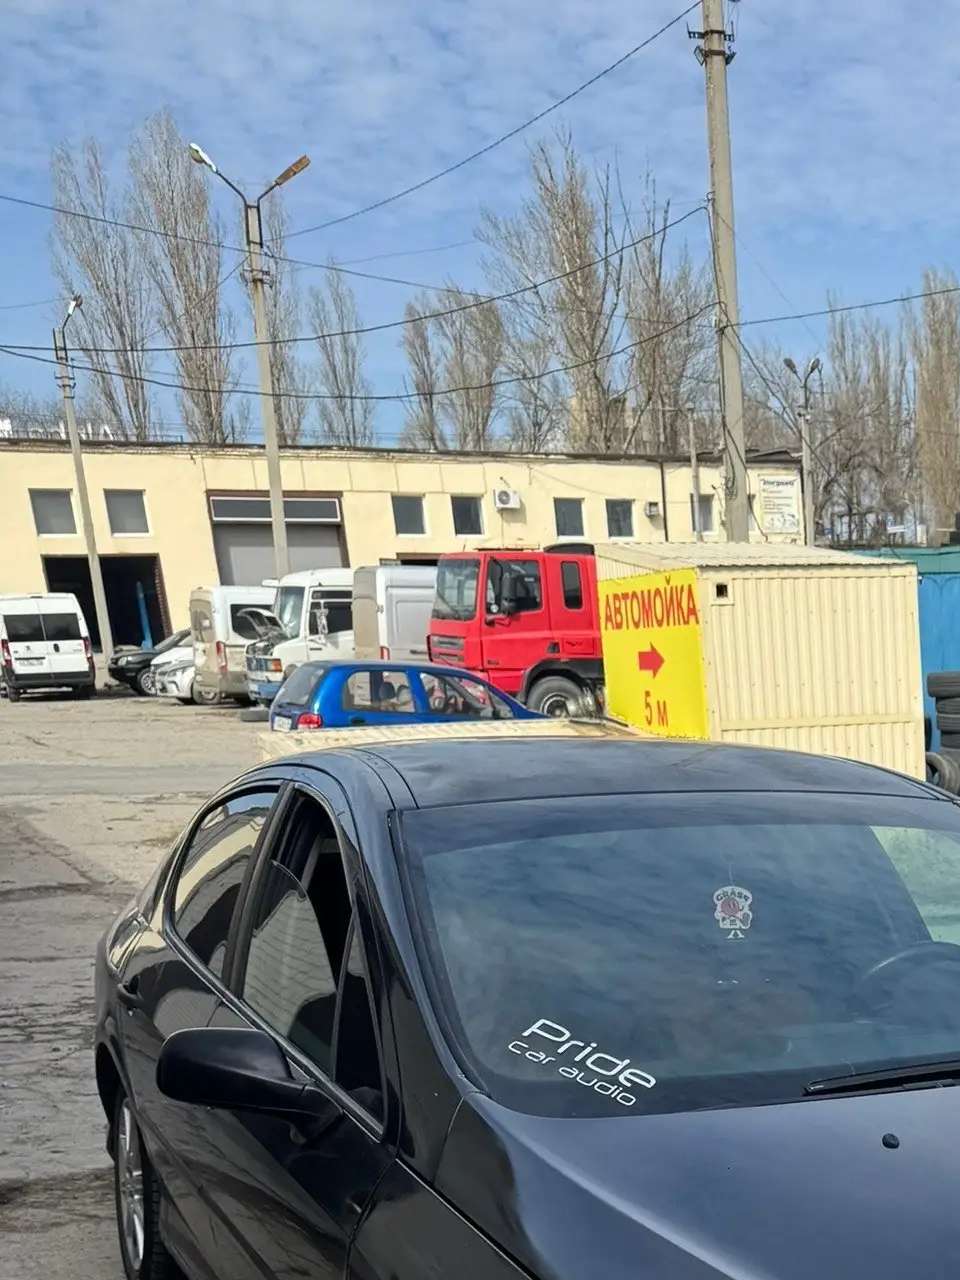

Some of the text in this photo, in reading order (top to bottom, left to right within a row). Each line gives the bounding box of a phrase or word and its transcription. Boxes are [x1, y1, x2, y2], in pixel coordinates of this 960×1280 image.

[604, 574, 700, 630] АВТОМОЙКА
[644, 690, 653, 726] 5
[716, 889, 750, 902] GRASS
[507, 1039, 636, 1107] car audio
[521, 1017, 657, 1089] Pride
